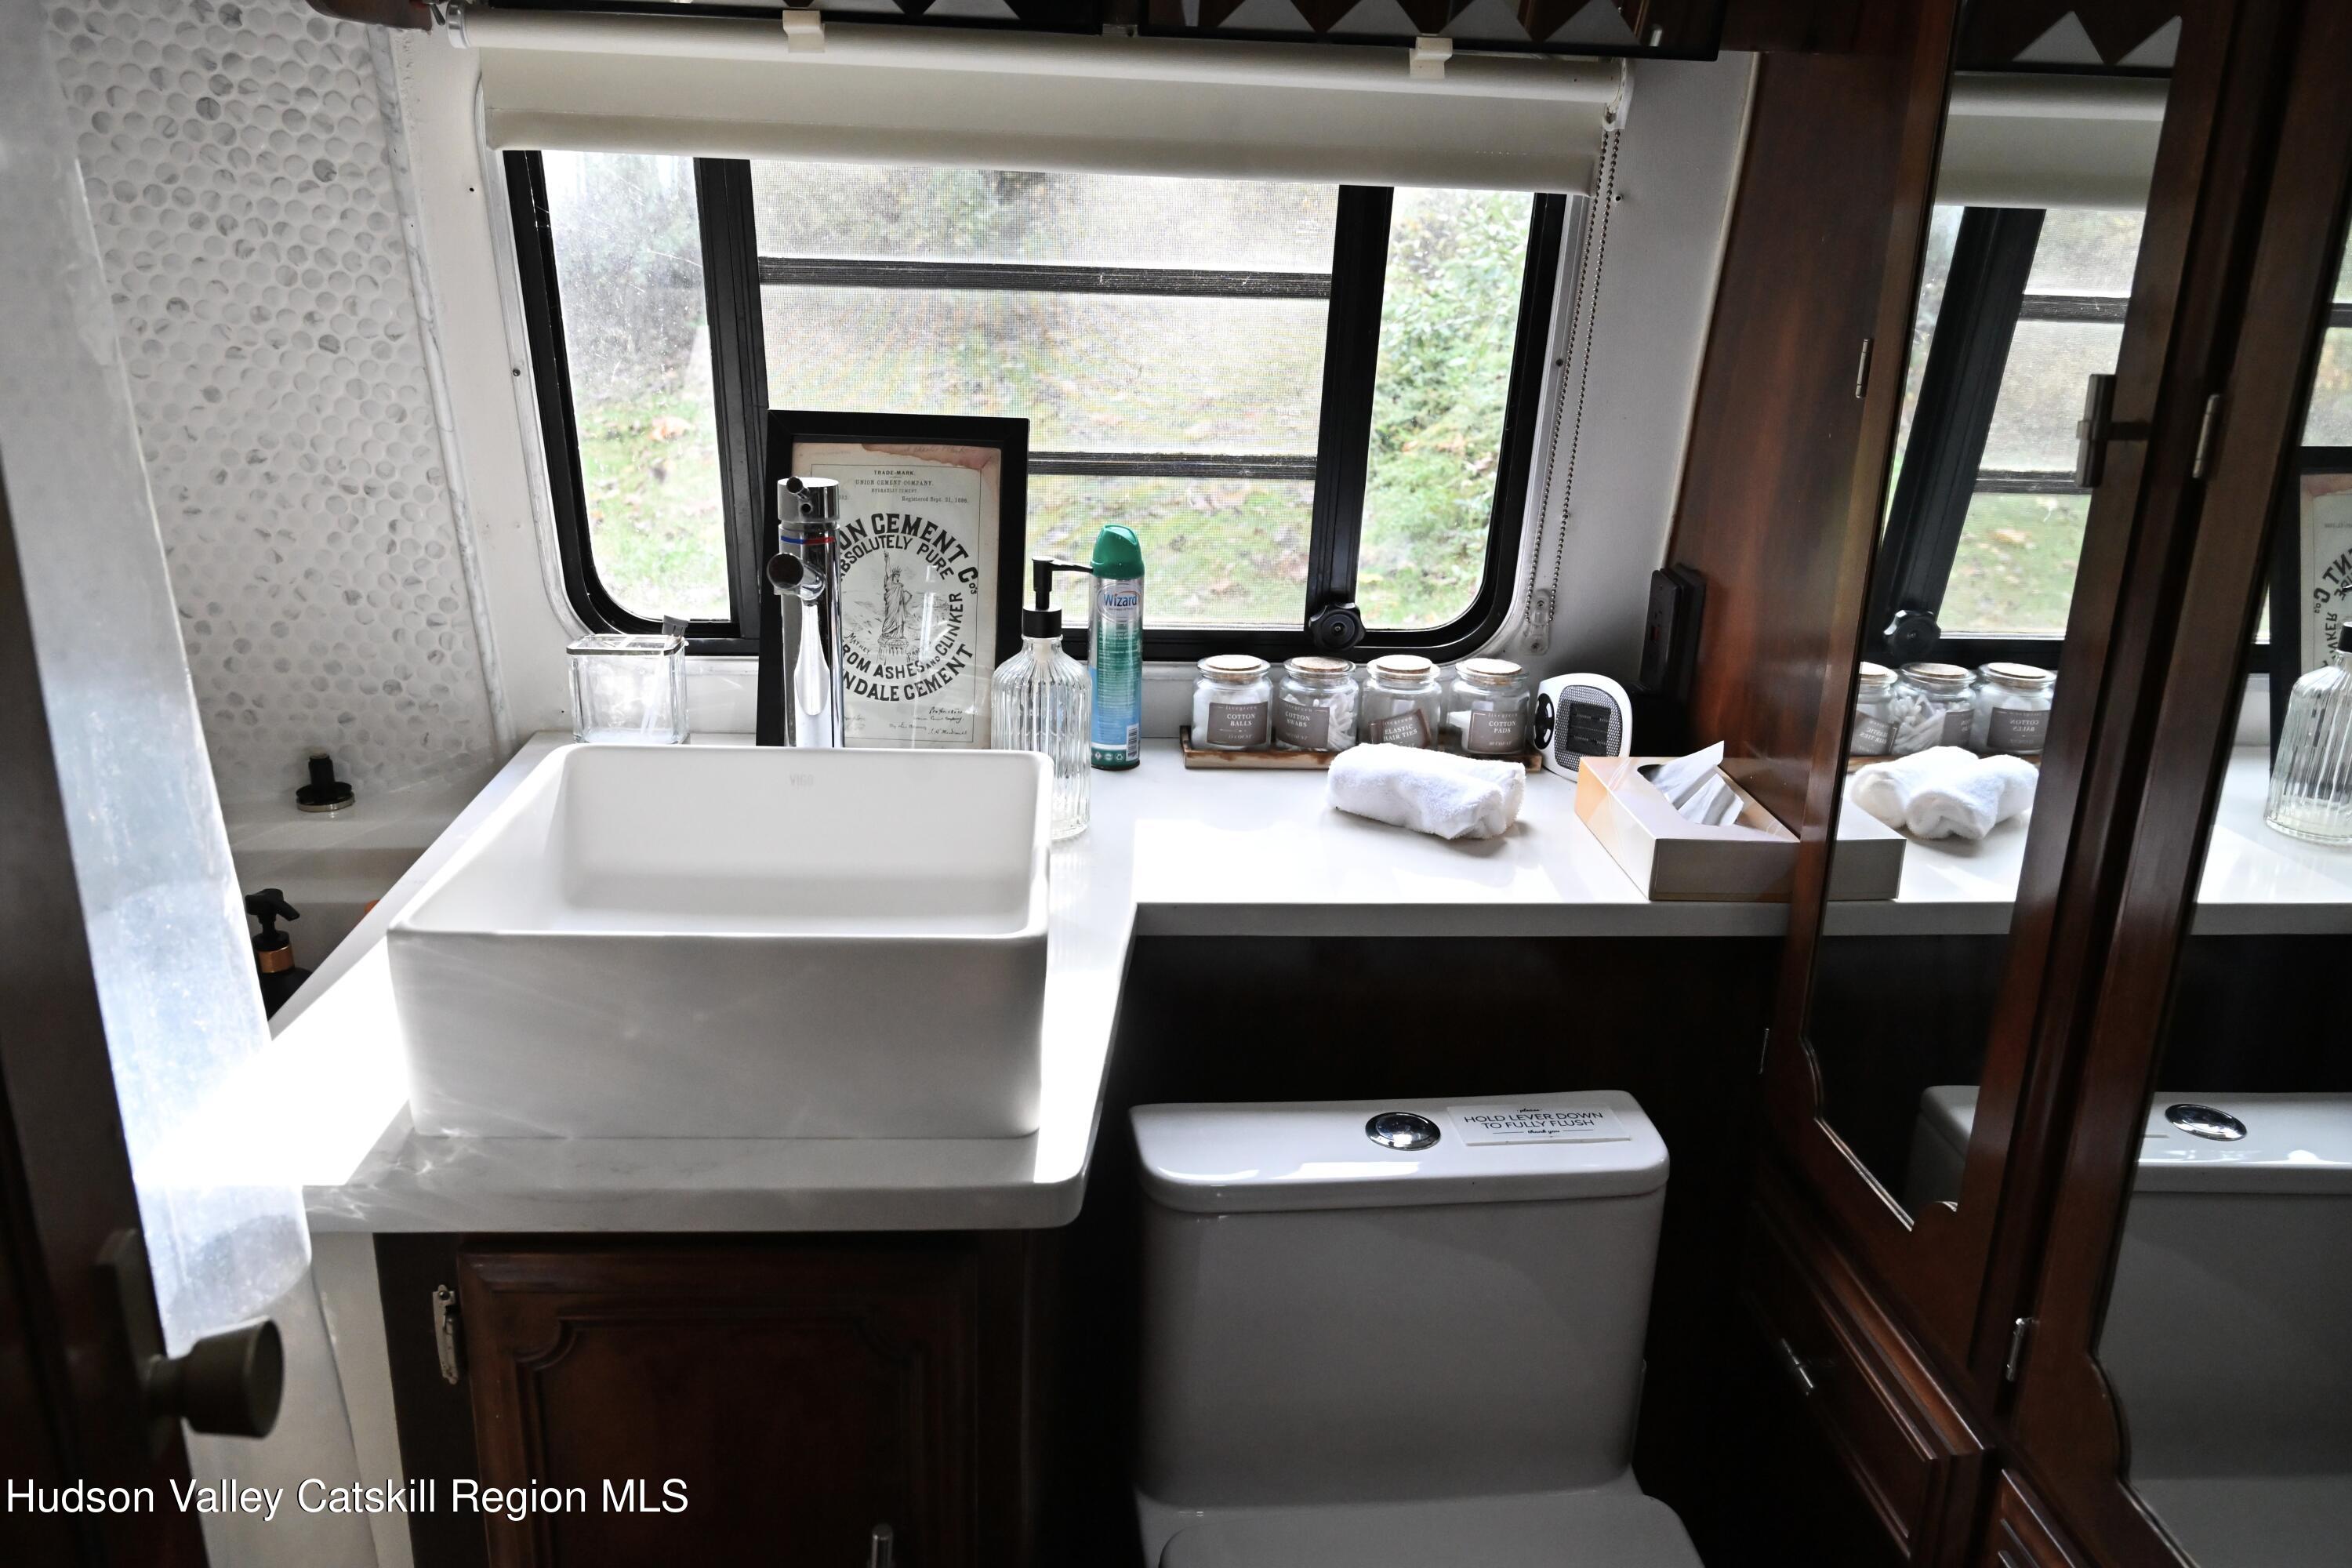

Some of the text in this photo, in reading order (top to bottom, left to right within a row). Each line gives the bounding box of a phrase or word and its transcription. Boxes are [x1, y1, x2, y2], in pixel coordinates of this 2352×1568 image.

[871, 513, 969, 563] CEMENT
[916, 543, 954, 580] PURE
[1103, 593, 1138, 607] Wizard
[842, 592, 964, 680] ROM ASHES AND CLINKER
[843, 643, 973, 702] NDALE CEMENT
[1285, 710, 1311, 721] COTTON
[1286, 718, 1308, 728] SWABS
[1385, 723, 1414, 735] ELASTIC
[1402, 728, 1418, 738] TIES
[1464, 1112, 1603, 1123] HOLD LEVER DOWN
[1550, 1119, 1595, 1127] FLUSH
